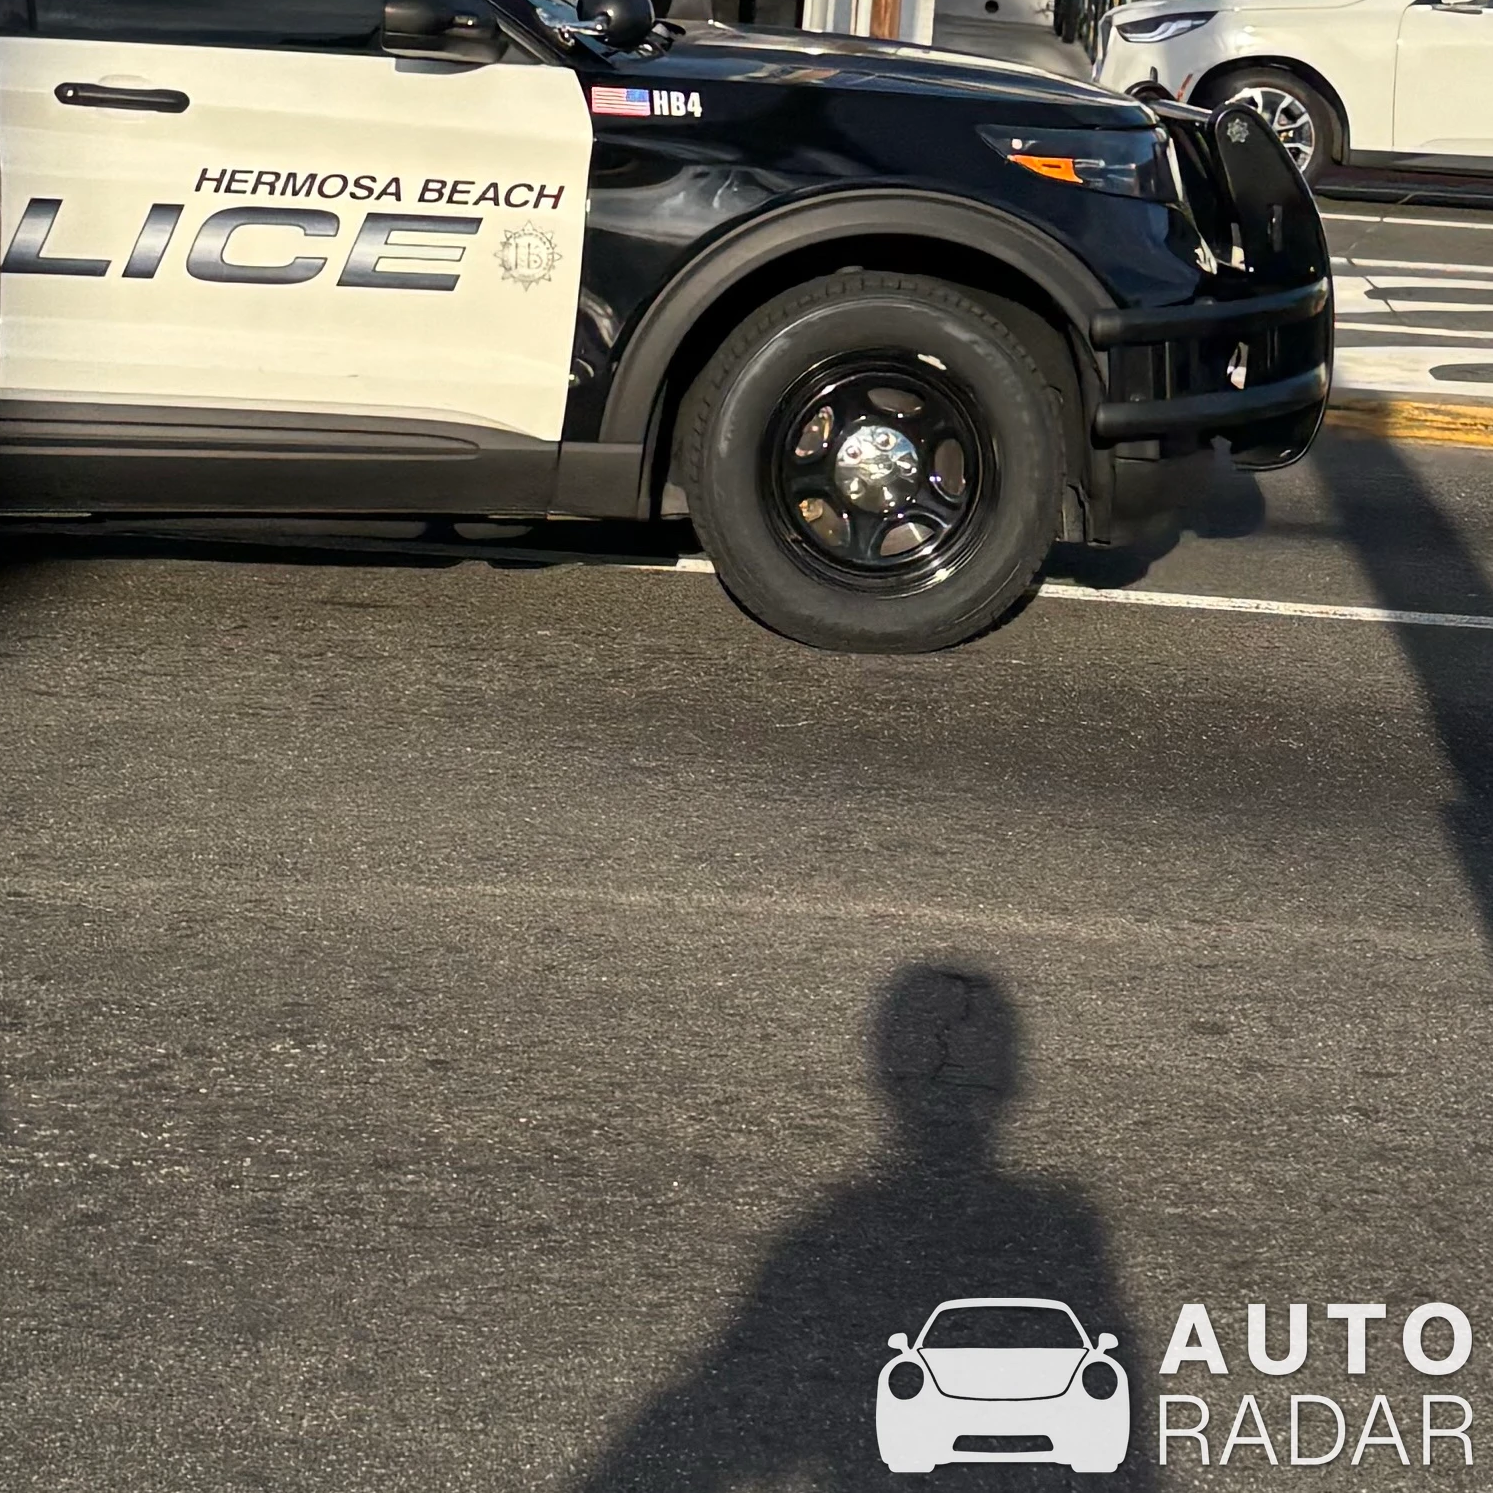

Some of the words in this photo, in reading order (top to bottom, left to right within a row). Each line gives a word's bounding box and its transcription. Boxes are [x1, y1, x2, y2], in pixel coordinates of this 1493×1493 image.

[653, 89, 702, 117] HB4
[194, 168, 402, 202] HERMOSA
[417, 179, 565, 210] BEACH
